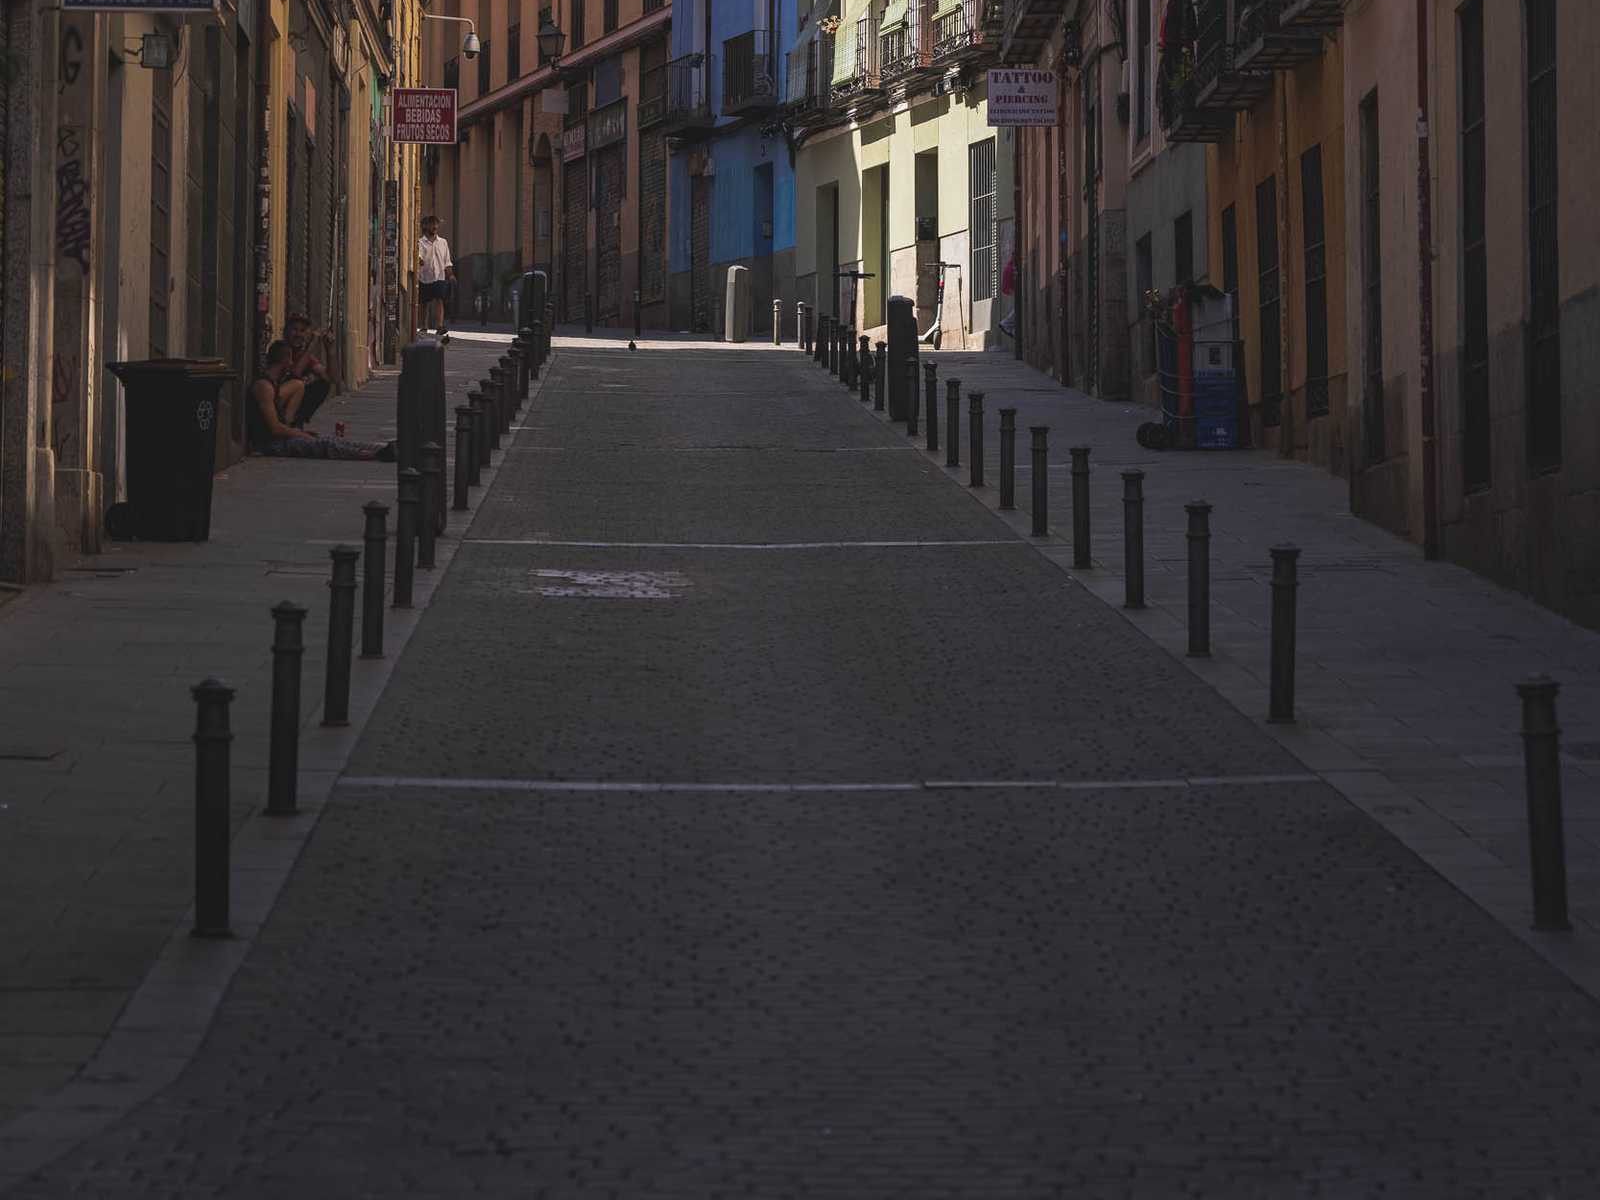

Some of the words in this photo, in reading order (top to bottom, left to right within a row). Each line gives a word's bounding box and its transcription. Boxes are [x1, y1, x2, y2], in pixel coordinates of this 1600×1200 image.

[991, 71, 1053, 84] TATTOO
[995, 95, 1049, 104] PIERCING
[405, 109, 441, 123] BEBIDAS
[397, 123, 425, 140] FRUTOS
[425, 123, 450, 140] SECOS
